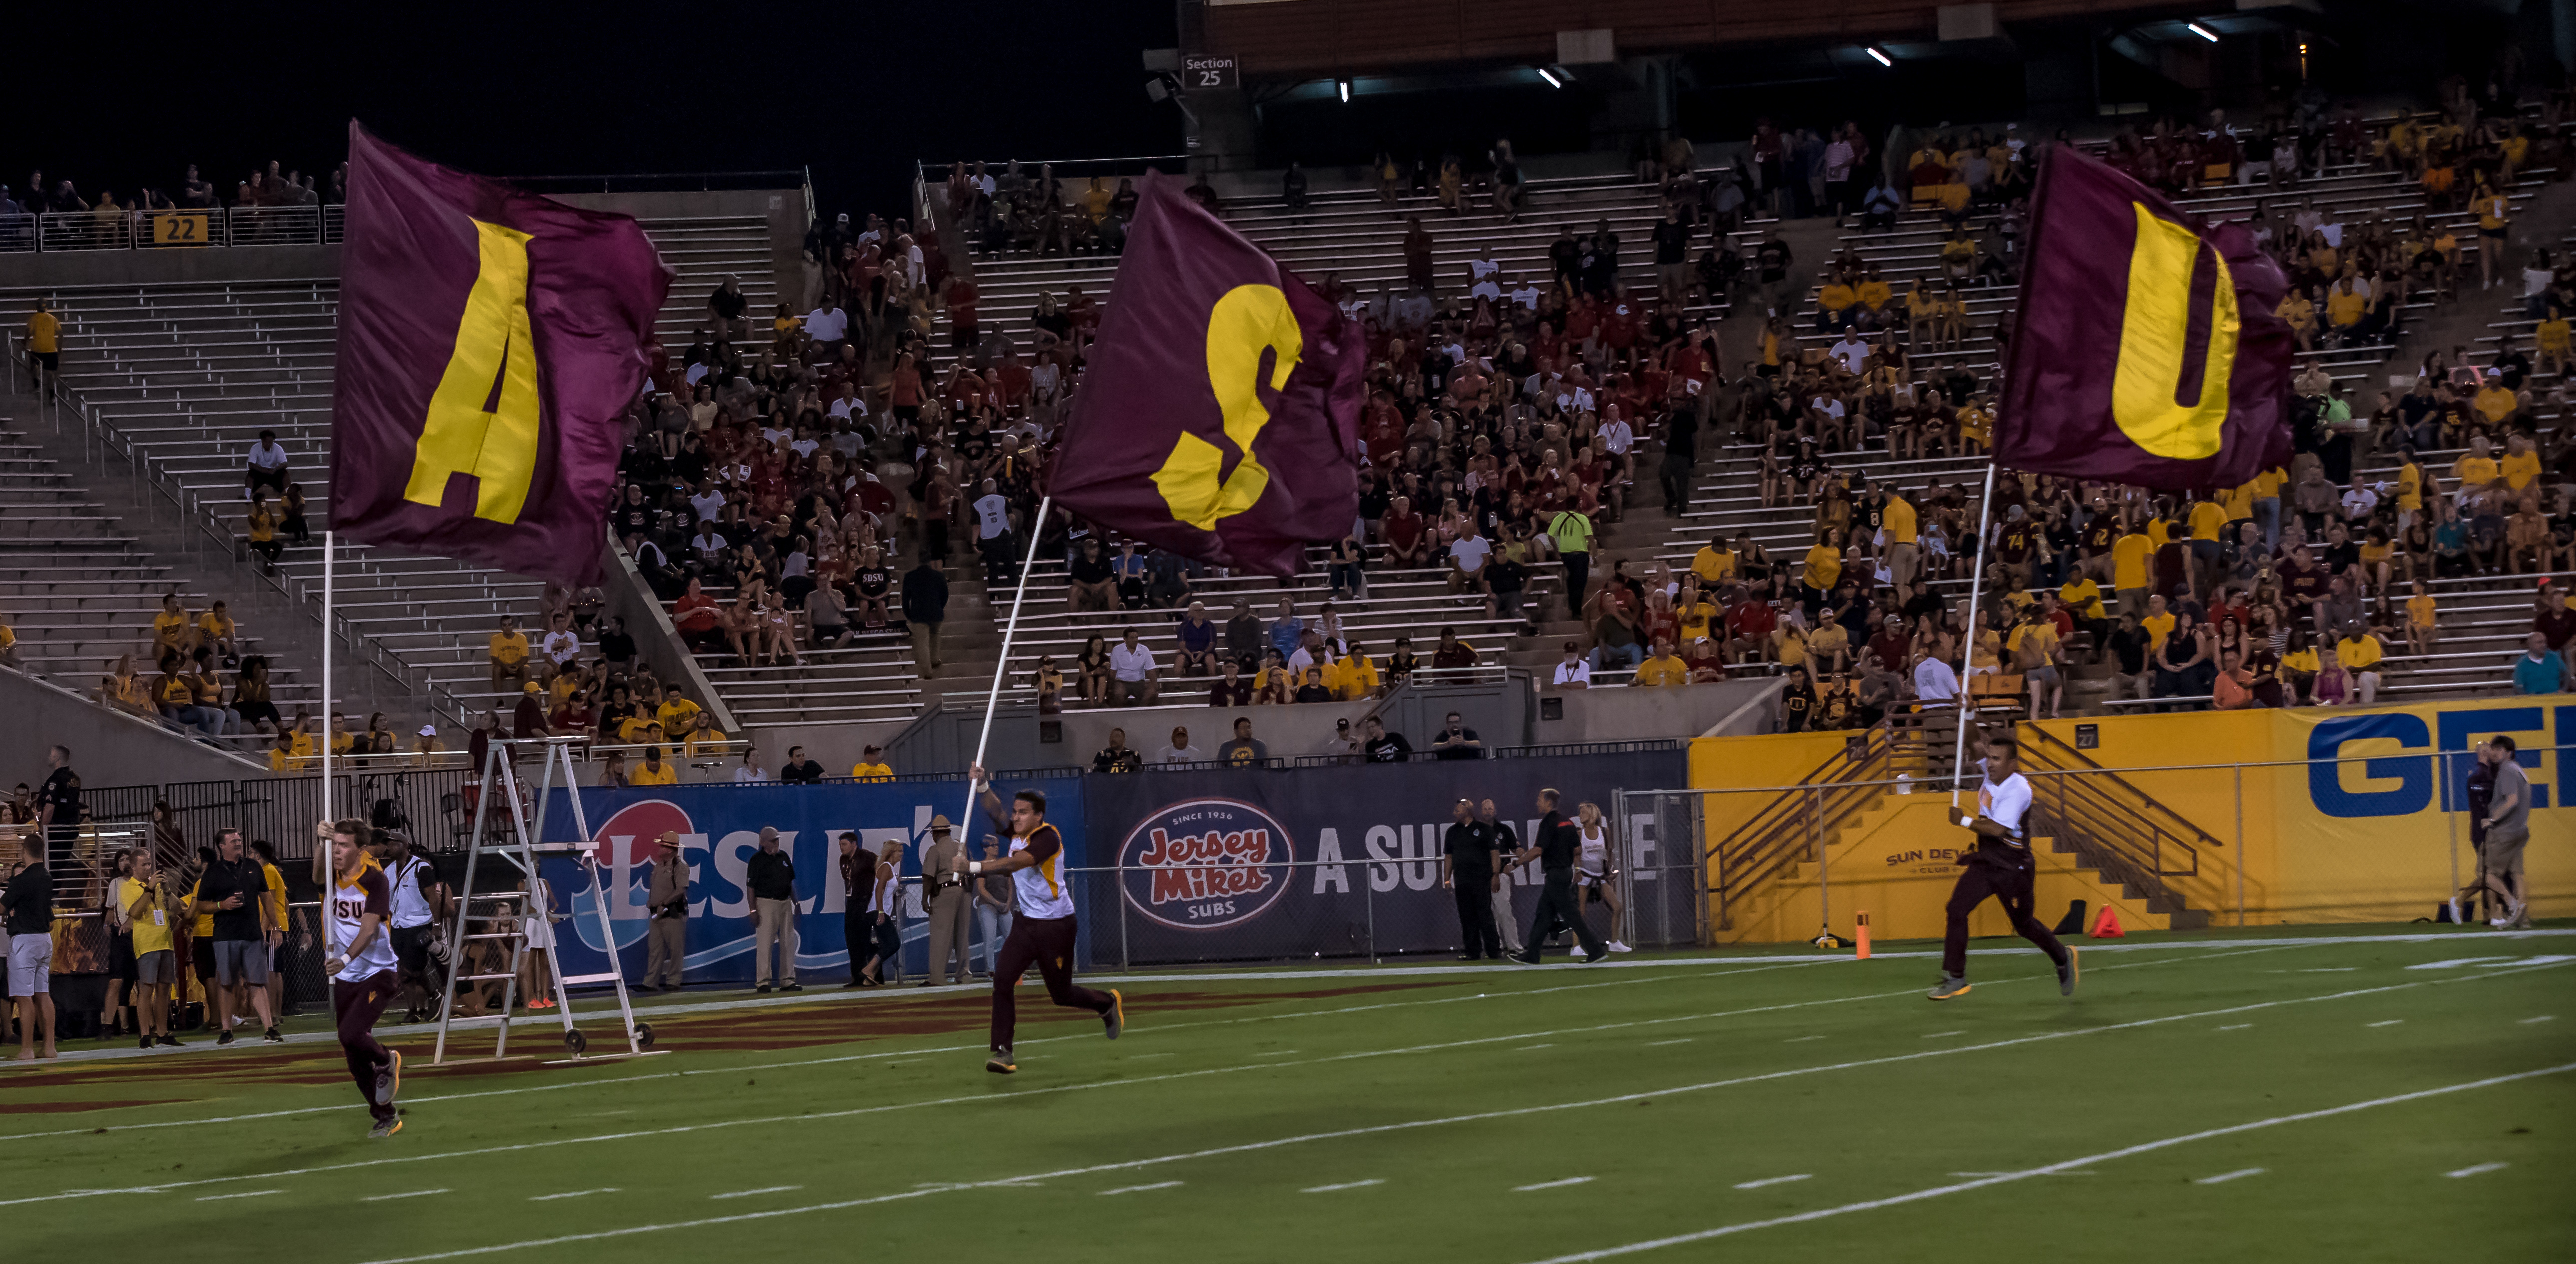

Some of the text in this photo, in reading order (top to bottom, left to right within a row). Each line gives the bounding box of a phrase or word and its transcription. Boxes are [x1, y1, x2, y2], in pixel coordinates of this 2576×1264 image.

[1186, 57, 1232, 70] Section
[1200, 70, 1220, 86] 25
[167, 218, 195, 240] 22
[2112, 201, 2242, 460] U
[404, 215, 535, 525] A
[1149, 283, 1303, 531] S
[2007, 534, 2024, 550] 74
[863, 573, 884, 582] SDSU
[2078, 734, 2094, 746] 27
[1173, 811, 1233, 825] SINCE 1956
[1139, 827, 1271, 867] Jersey
[1313, 827, 1350, 894] A
[1886, 849, 1923, 867] SUN
[1187, 900, 1236, 919] SUBS
